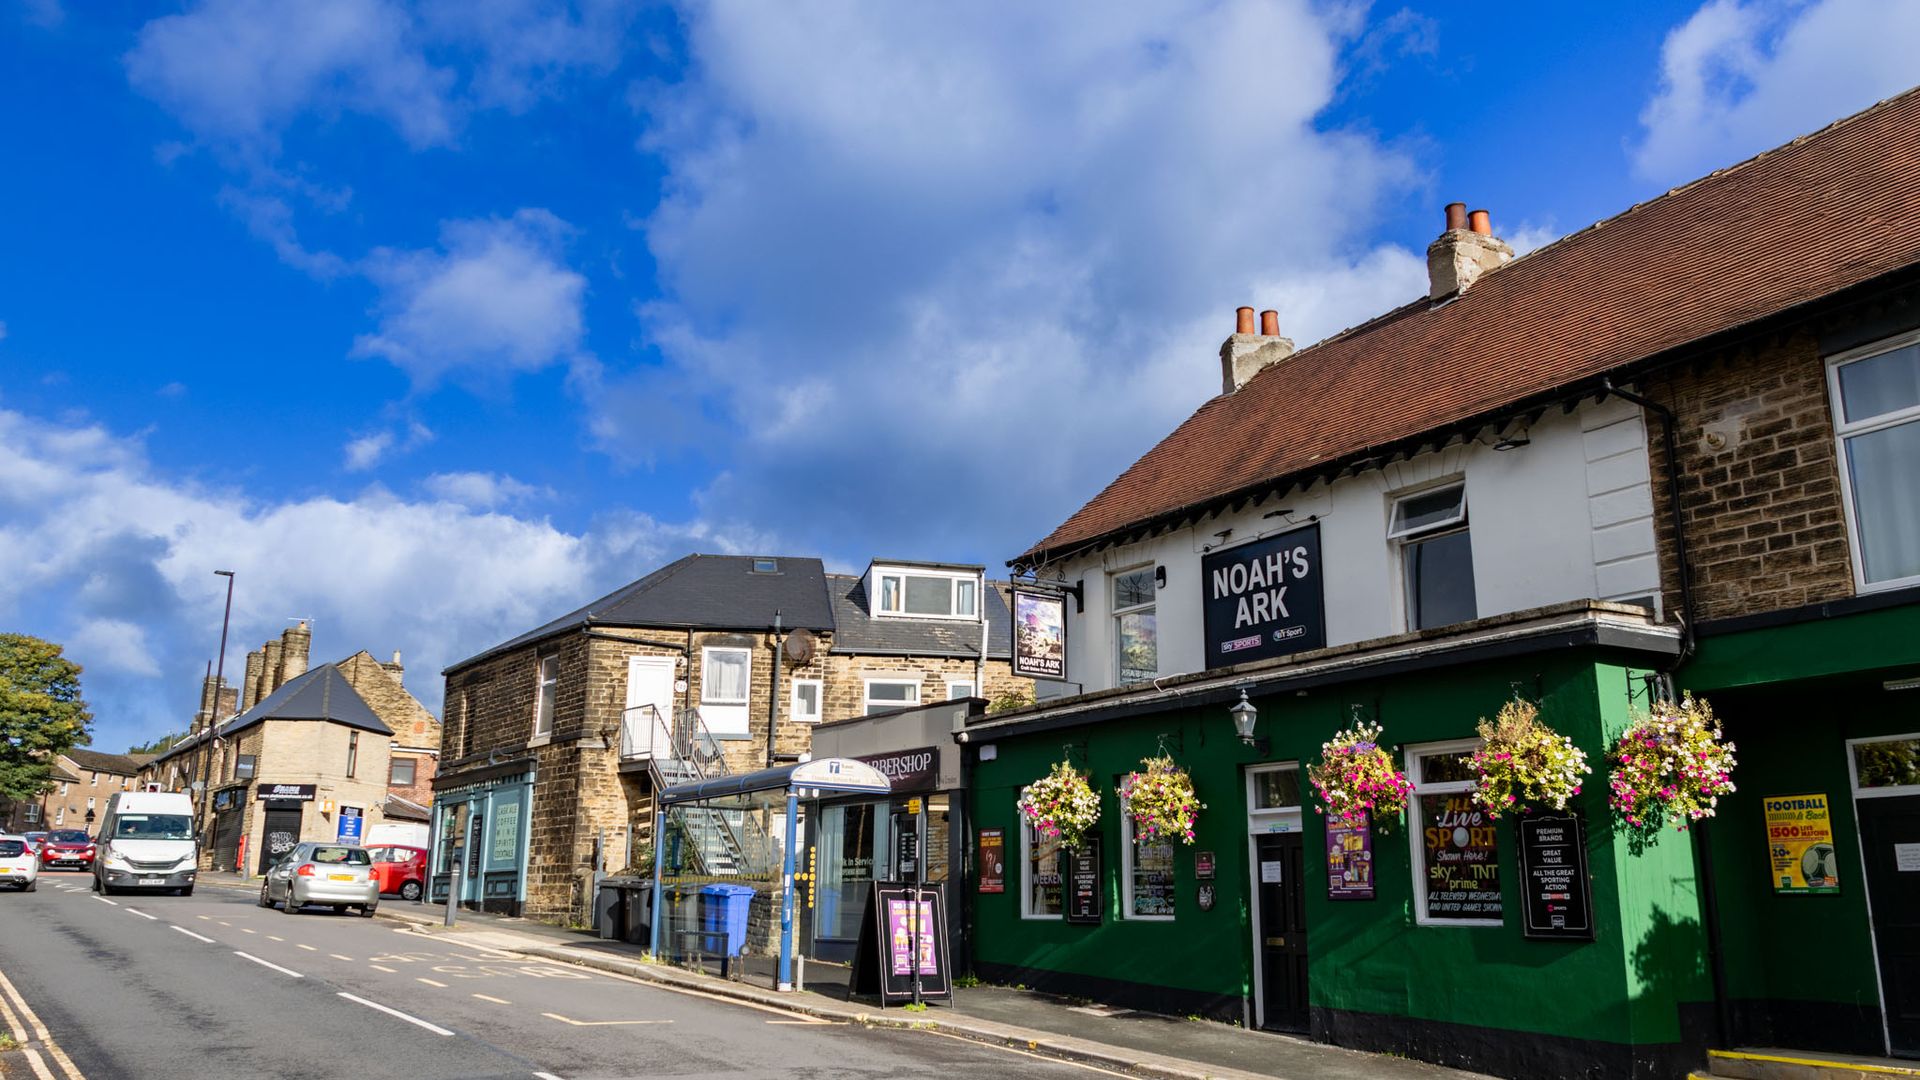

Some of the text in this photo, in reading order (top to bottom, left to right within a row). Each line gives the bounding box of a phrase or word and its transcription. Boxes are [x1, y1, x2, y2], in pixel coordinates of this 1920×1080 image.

[1213, 546, 1309, 600] NOAH'S
[1234, 586, 1290, 629] ARK
[1286, 627, 1303, 638] Sport
[1223, 637, 1260, 651] sky SPORTS
[1019, 656, 1060, 669] NOAH'S ARK
[1766, 798, 1825, 811] FOOTBALL
[497, 817, 516, 826] COFFEE
[1437, 810, 1483, 828] Live
[1805, 811, 1826, 820] Back
[1424, 826, 1497, 848] SPORT
[1536, 828, 1564, 836] PREMIUM
[1770, 826, 1799, 837] 1500
[1538, 834, 1563, 842] BRANDS
[1437, 850, 1489, 861] Shown Here!
[1470, 864, 1498, 879] TNT
[1032, 873, 1063, 885] WEEKEN
[1449, 877, 1479, 891] prime
[1428, 891, 1439, 900] ALL
[1468, 891, 1502, 901] WEDNESDA
[1429, 902, 1441, 911] AND
[1441, 903, 1461, 911] UNITED
